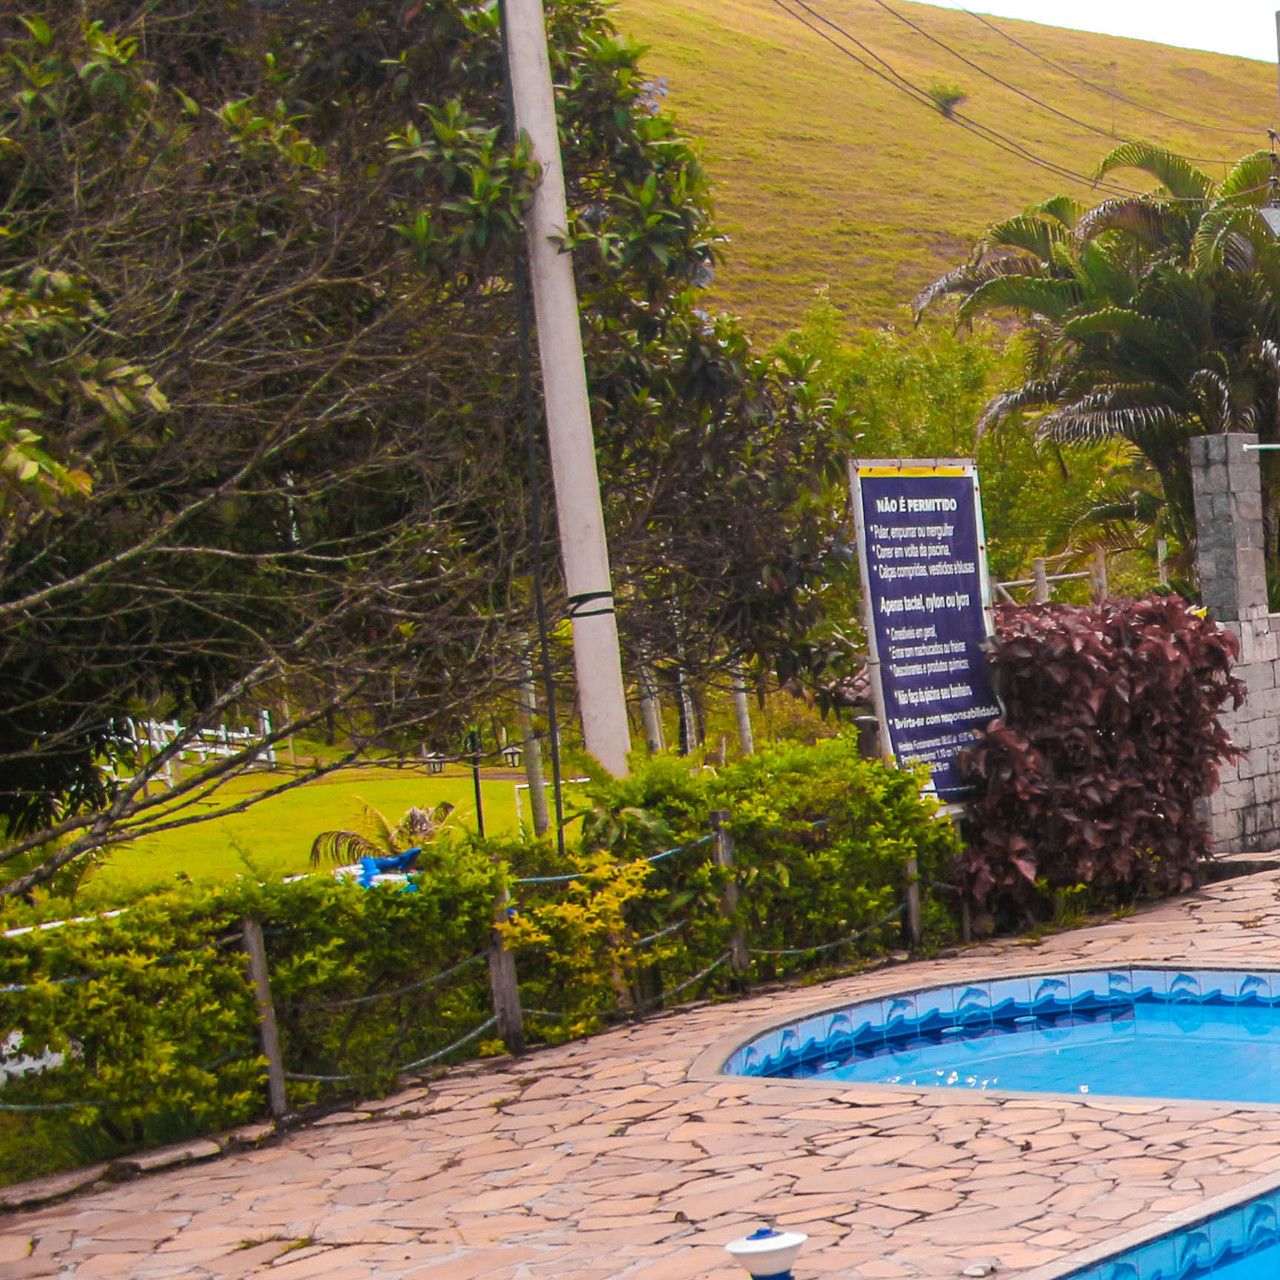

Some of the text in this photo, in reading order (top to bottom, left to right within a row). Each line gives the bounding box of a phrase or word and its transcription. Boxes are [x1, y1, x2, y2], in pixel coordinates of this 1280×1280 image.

[877, 496, 957, 512] NÃO É PERMITIDO
[891, 527, 916, 541] empurrar
[918, 527, 925, 537] ou
[926, 523, 954, 540] mergulhar
[876, 544, 893, 558] Correr
[894, 547, 903, 558] em
[904, 544, 918, 557] volta
[879, 564, 896, 581] Calças
[881, 597, 903, 616] Apenas
[926, 593, 945, 613] nylon
[946, 596, 955, 607] ou
[955, 591, 969, 611] lycra
[926, 715, 940, 725] com
